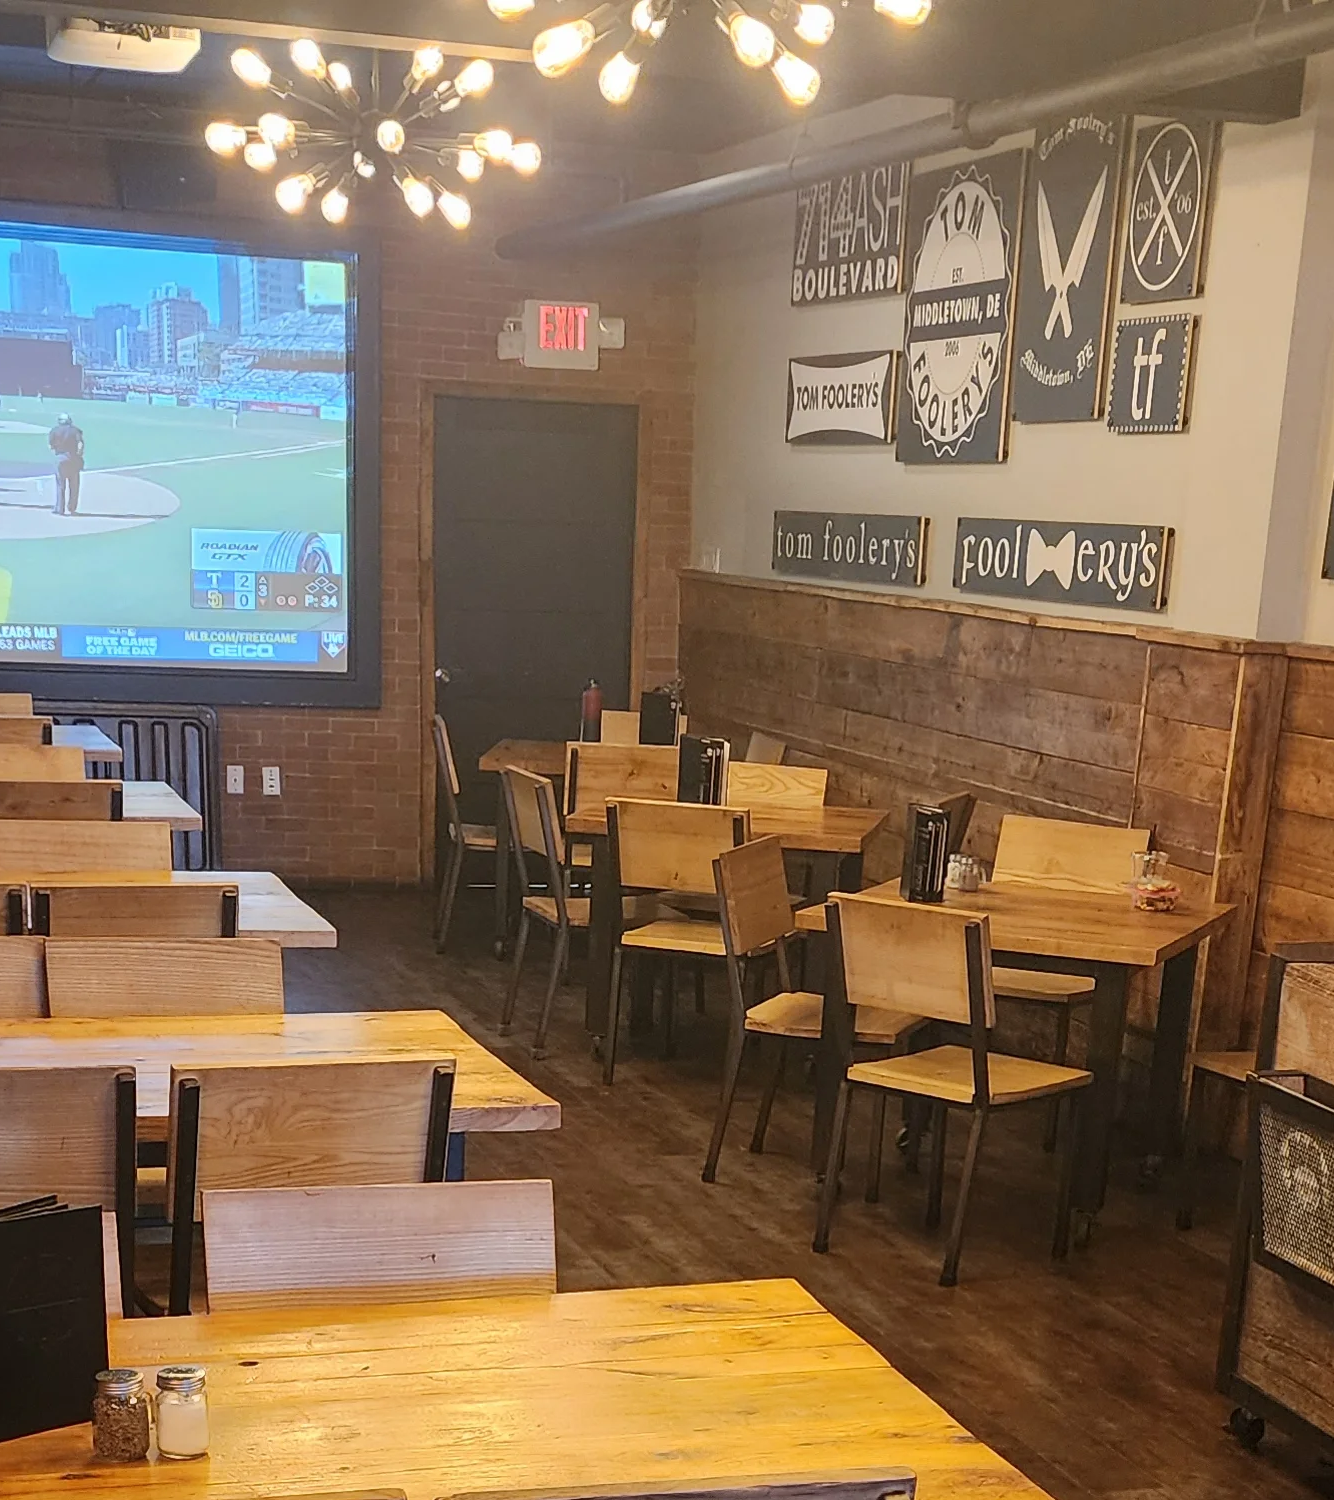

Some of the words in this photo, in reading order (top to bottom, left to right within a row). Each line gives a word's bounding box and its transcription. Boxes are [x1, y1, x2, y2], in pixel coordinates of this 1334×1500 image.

[795, 176, 854, 265] 714
[851, 162, 905, 254] ASH
[1136, 196, 1157, 221] est.
[1174, 191, 1192, 214] '06
[940, 191, 985, 242] TOM
[792, 255, 898, 301] BOULEVARD
[952, 267, 964, 284] EST.
[913, 296, 984, 327] MIDDLETOWN,
[986, 293, 1002, 318] DE
[539, 304, 589, 351] EXIT
[944, 341, 960, 357] 2006
[1132, 328, 1166, 421] tf
[796, 385, 818, 411] TOM
[822, 372, 879, 410] FOOLERY'S
[913, 341, 994, 437] FOOLERY'S
[200, 542, 259, 551] ROADIAN
[777, 526, 812, 559] tom
[823, 520, 917, 580] foolery's
[210, 553, 248, 561] GTX
[239, 575, 249, 588] 2
[258, 585, 268, 597] 3
[239, 595, 249, 607] 0
[33, 626, 58, 639] MLB
[184, 631, 298, 644] MLB.COM/FREEGAME
[15, 639, 56, 651] GAMES
[85, 636, 119, 646] FREE
[120, 637, 158, 647] GAME
[86, 645, 104, 655] OF
[105, 646, 130, 655] THE
[131, 646, 157, 656] DAY
[208, 643, 276, 658] GEICO
